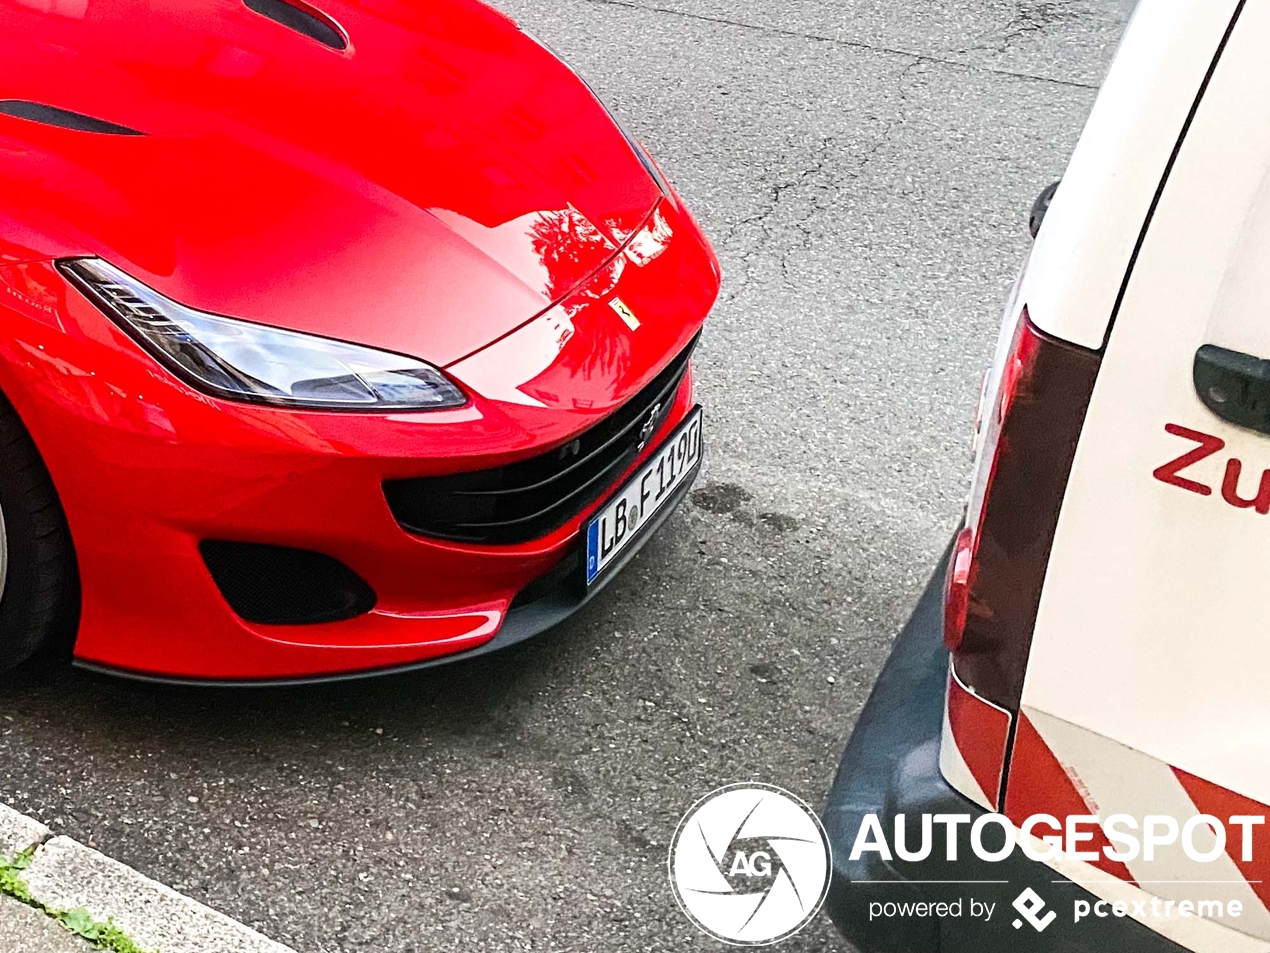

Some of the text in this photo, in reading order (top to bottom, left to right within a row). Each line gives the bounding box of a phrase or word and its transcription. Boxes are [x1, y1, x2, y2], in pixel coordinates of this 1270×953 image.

[601, 419, 698, 561] LB F 1190
[1152, 422, 1270, 516] Zu
